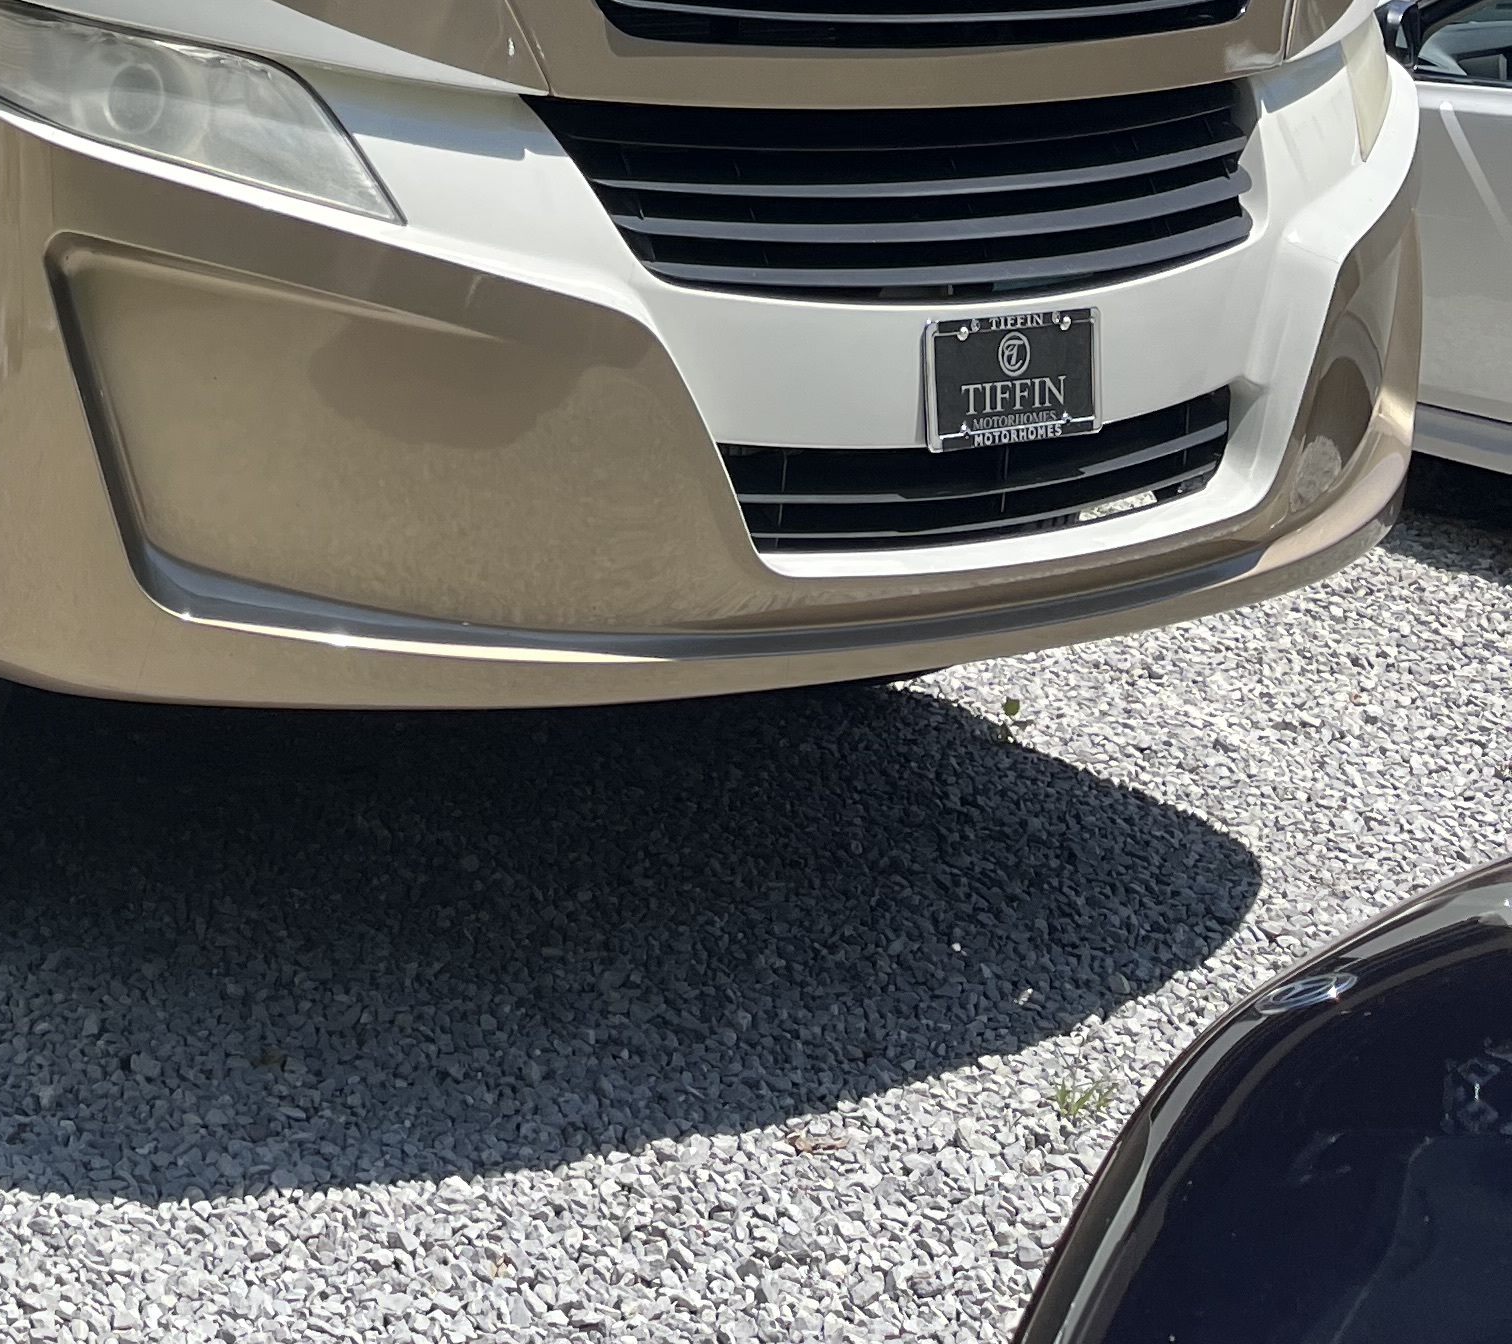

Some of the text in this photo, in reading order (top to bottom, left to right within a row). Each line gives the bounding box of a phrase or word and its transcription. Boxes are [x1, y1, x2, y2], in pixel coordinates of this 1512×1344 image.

[989, 314, 1044, 330] TIFFIN
[961, 375, 1067, 415] TIFFIN
[973, 410, 1058, 430] MOTORHOMES
[974, 424, 1063, 447] MOTORHOMES
